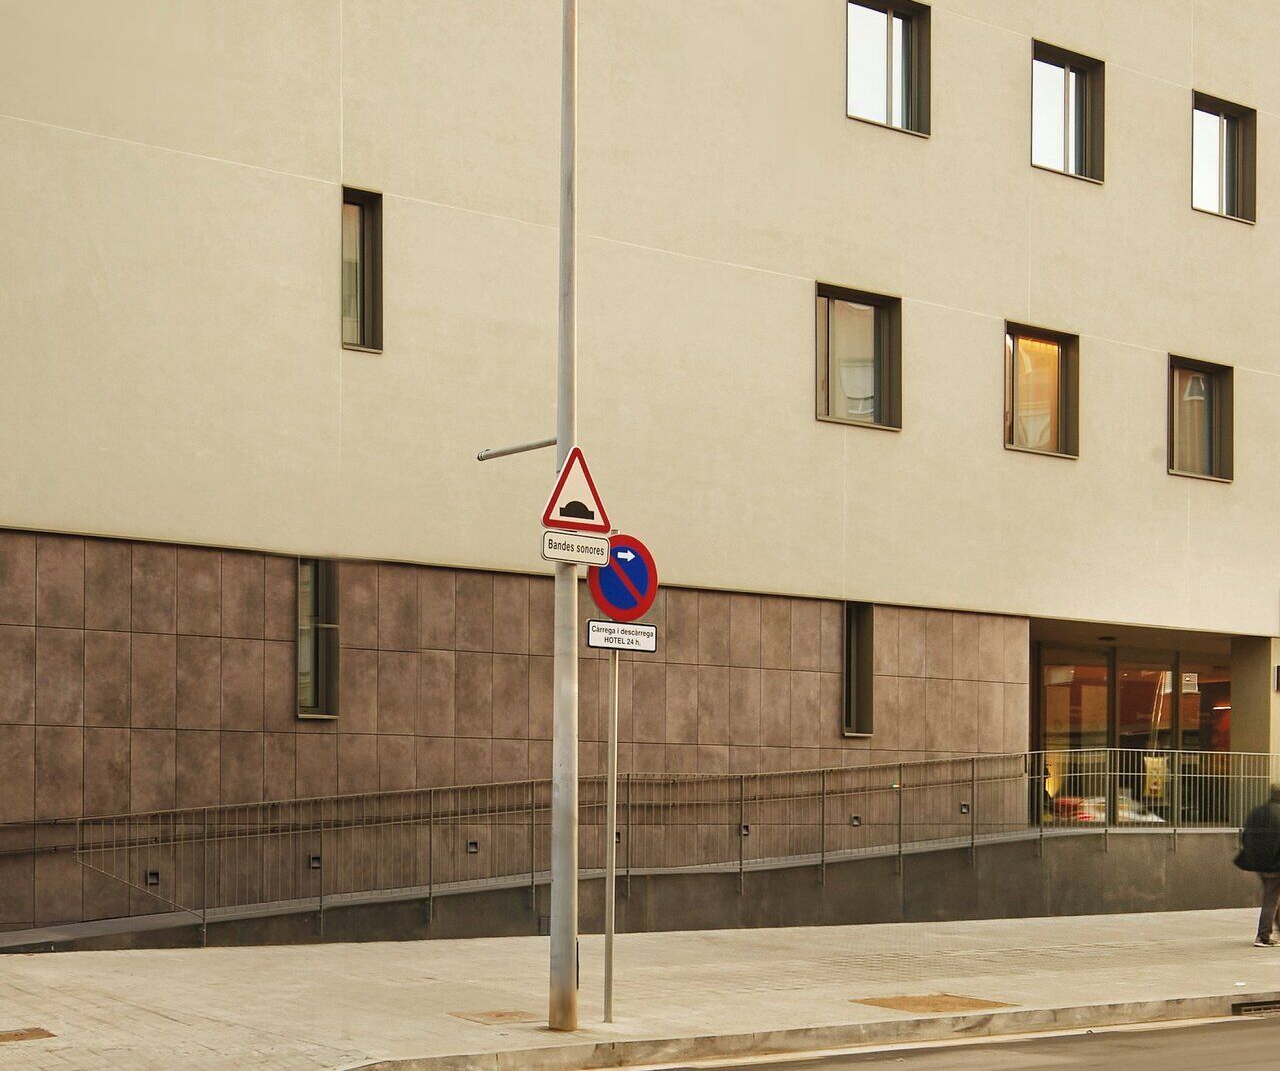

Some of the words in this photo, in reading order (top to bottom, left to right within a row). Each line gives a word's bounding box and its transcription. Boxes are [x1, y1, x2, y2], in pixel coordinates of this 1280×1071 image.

[548, 538, 575, 553] Bandes
[576, 544, 605, 556] sonores
[591, 625, 616, 635] Càrrega
[604, 636, 626, 645] HOTEL
[626, 637, 634, 645] 24
